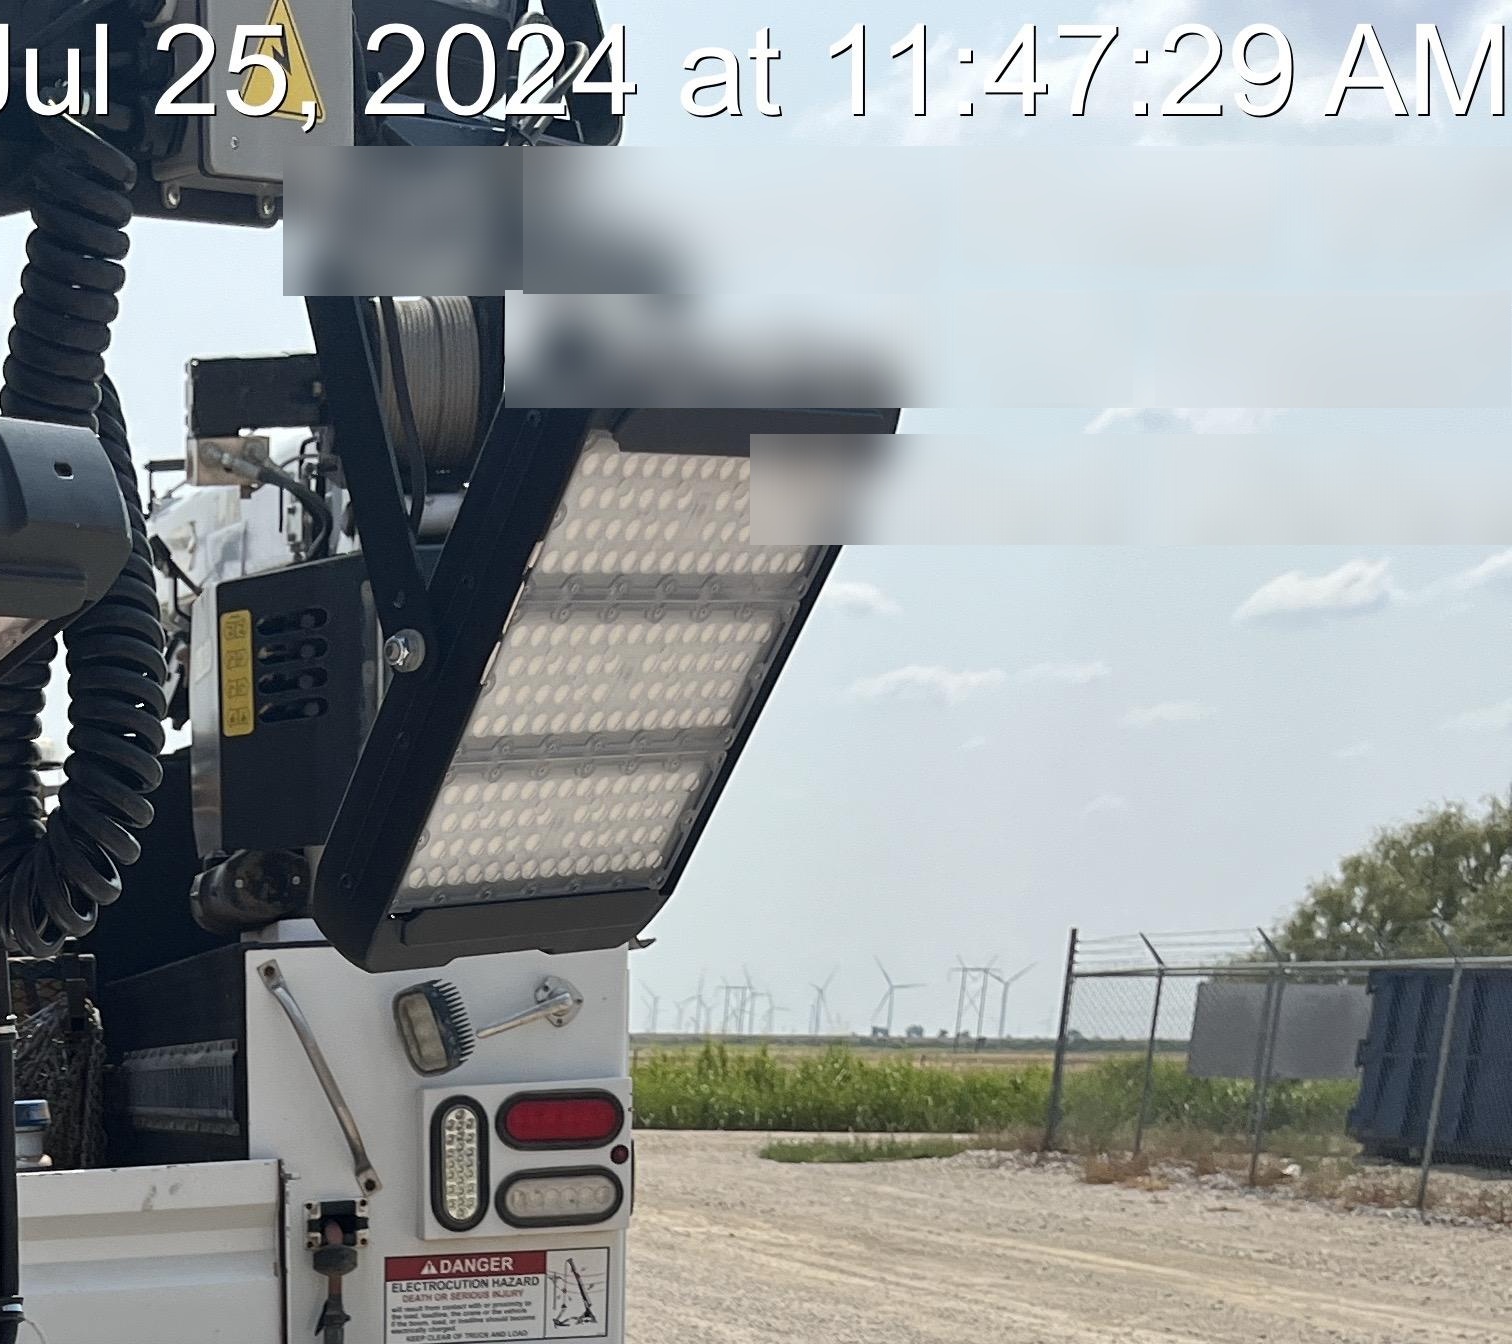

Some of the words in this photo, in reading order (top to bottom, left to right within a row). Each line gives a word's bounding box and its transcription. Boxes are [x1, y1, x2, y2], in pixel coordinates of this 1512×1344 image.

[439, 1257, 513, 1273] DANGER
[391, 1278, 488, 1292] ELECTROCUTION
[491, 1276, 539, 1287] HAZARD
